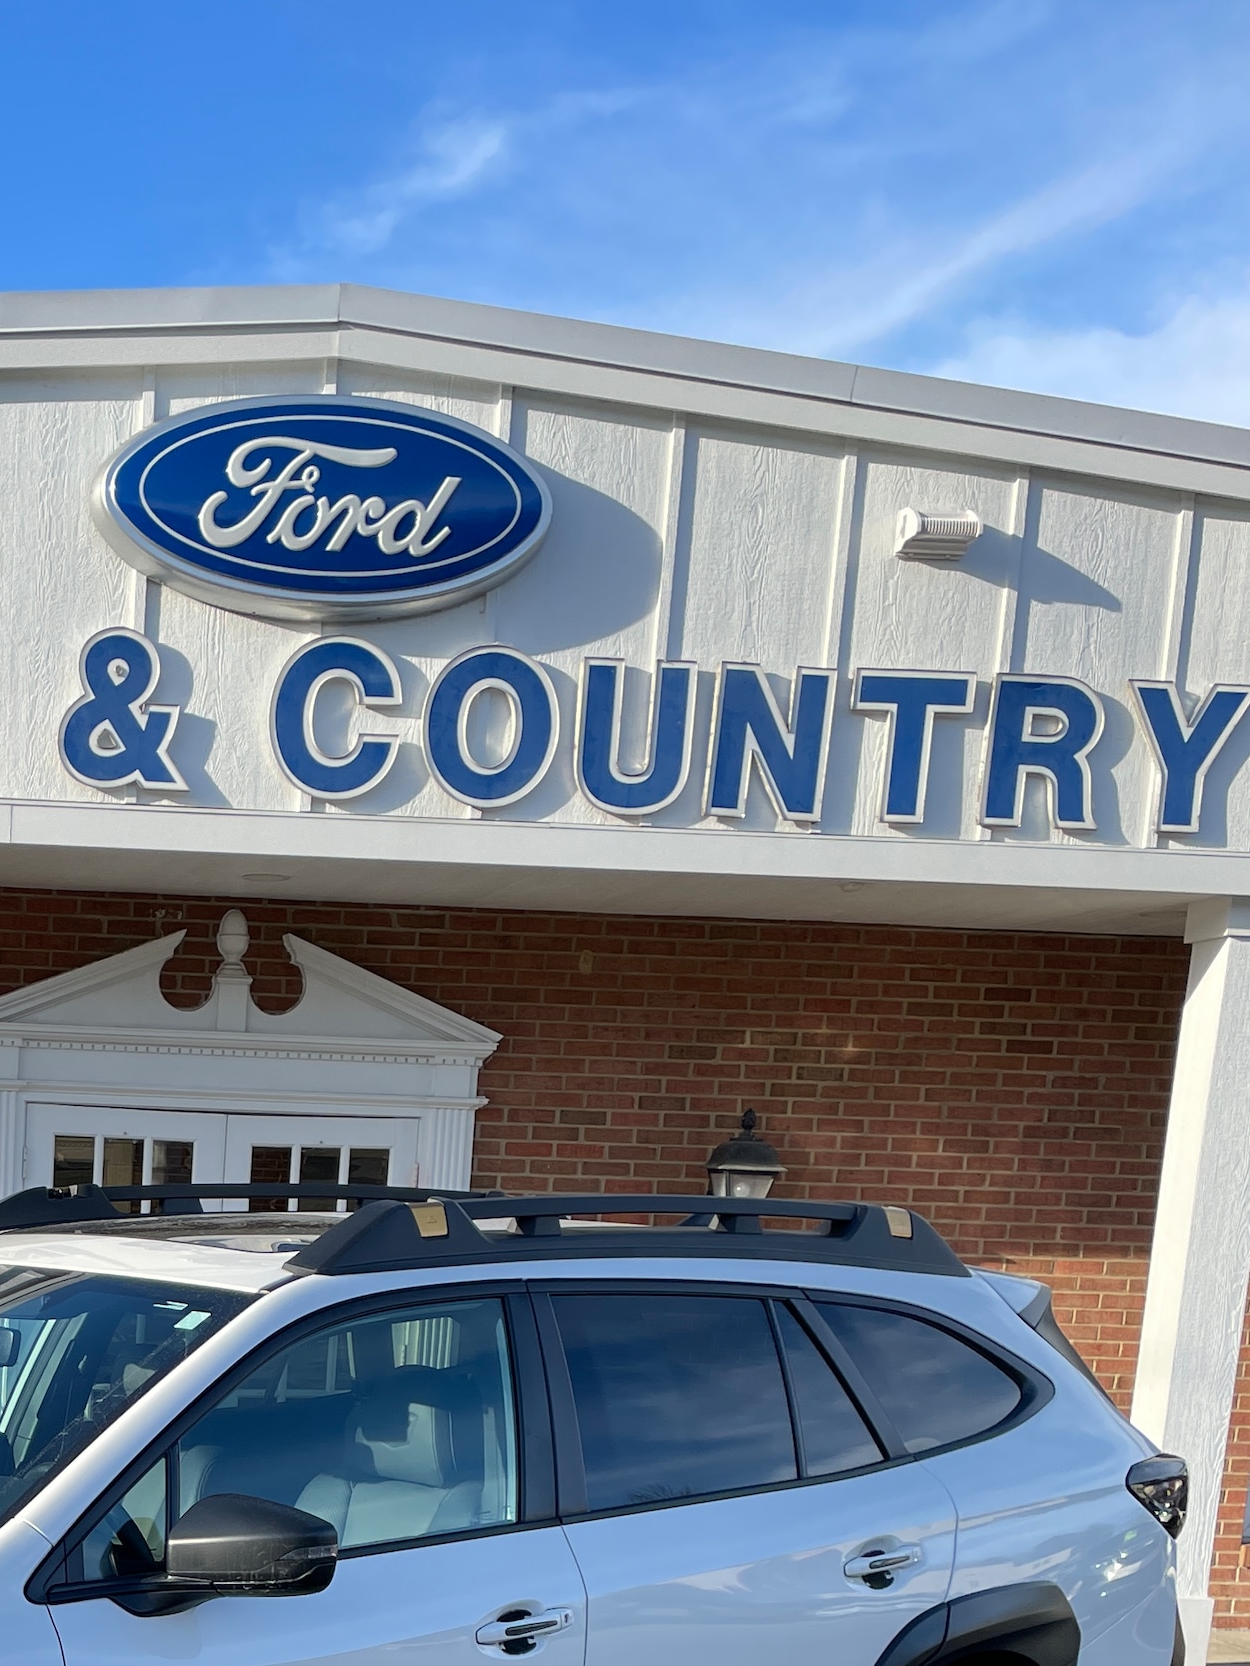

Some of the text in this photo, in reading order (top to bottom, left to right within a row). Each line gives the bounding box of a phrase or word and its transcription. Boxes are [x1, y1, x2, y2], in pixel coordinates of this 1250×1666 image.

[197, 436, 463, 558] Ford
[58, 627, 190, 792] &
[269, 635, 1250, 833] COUNTRY
